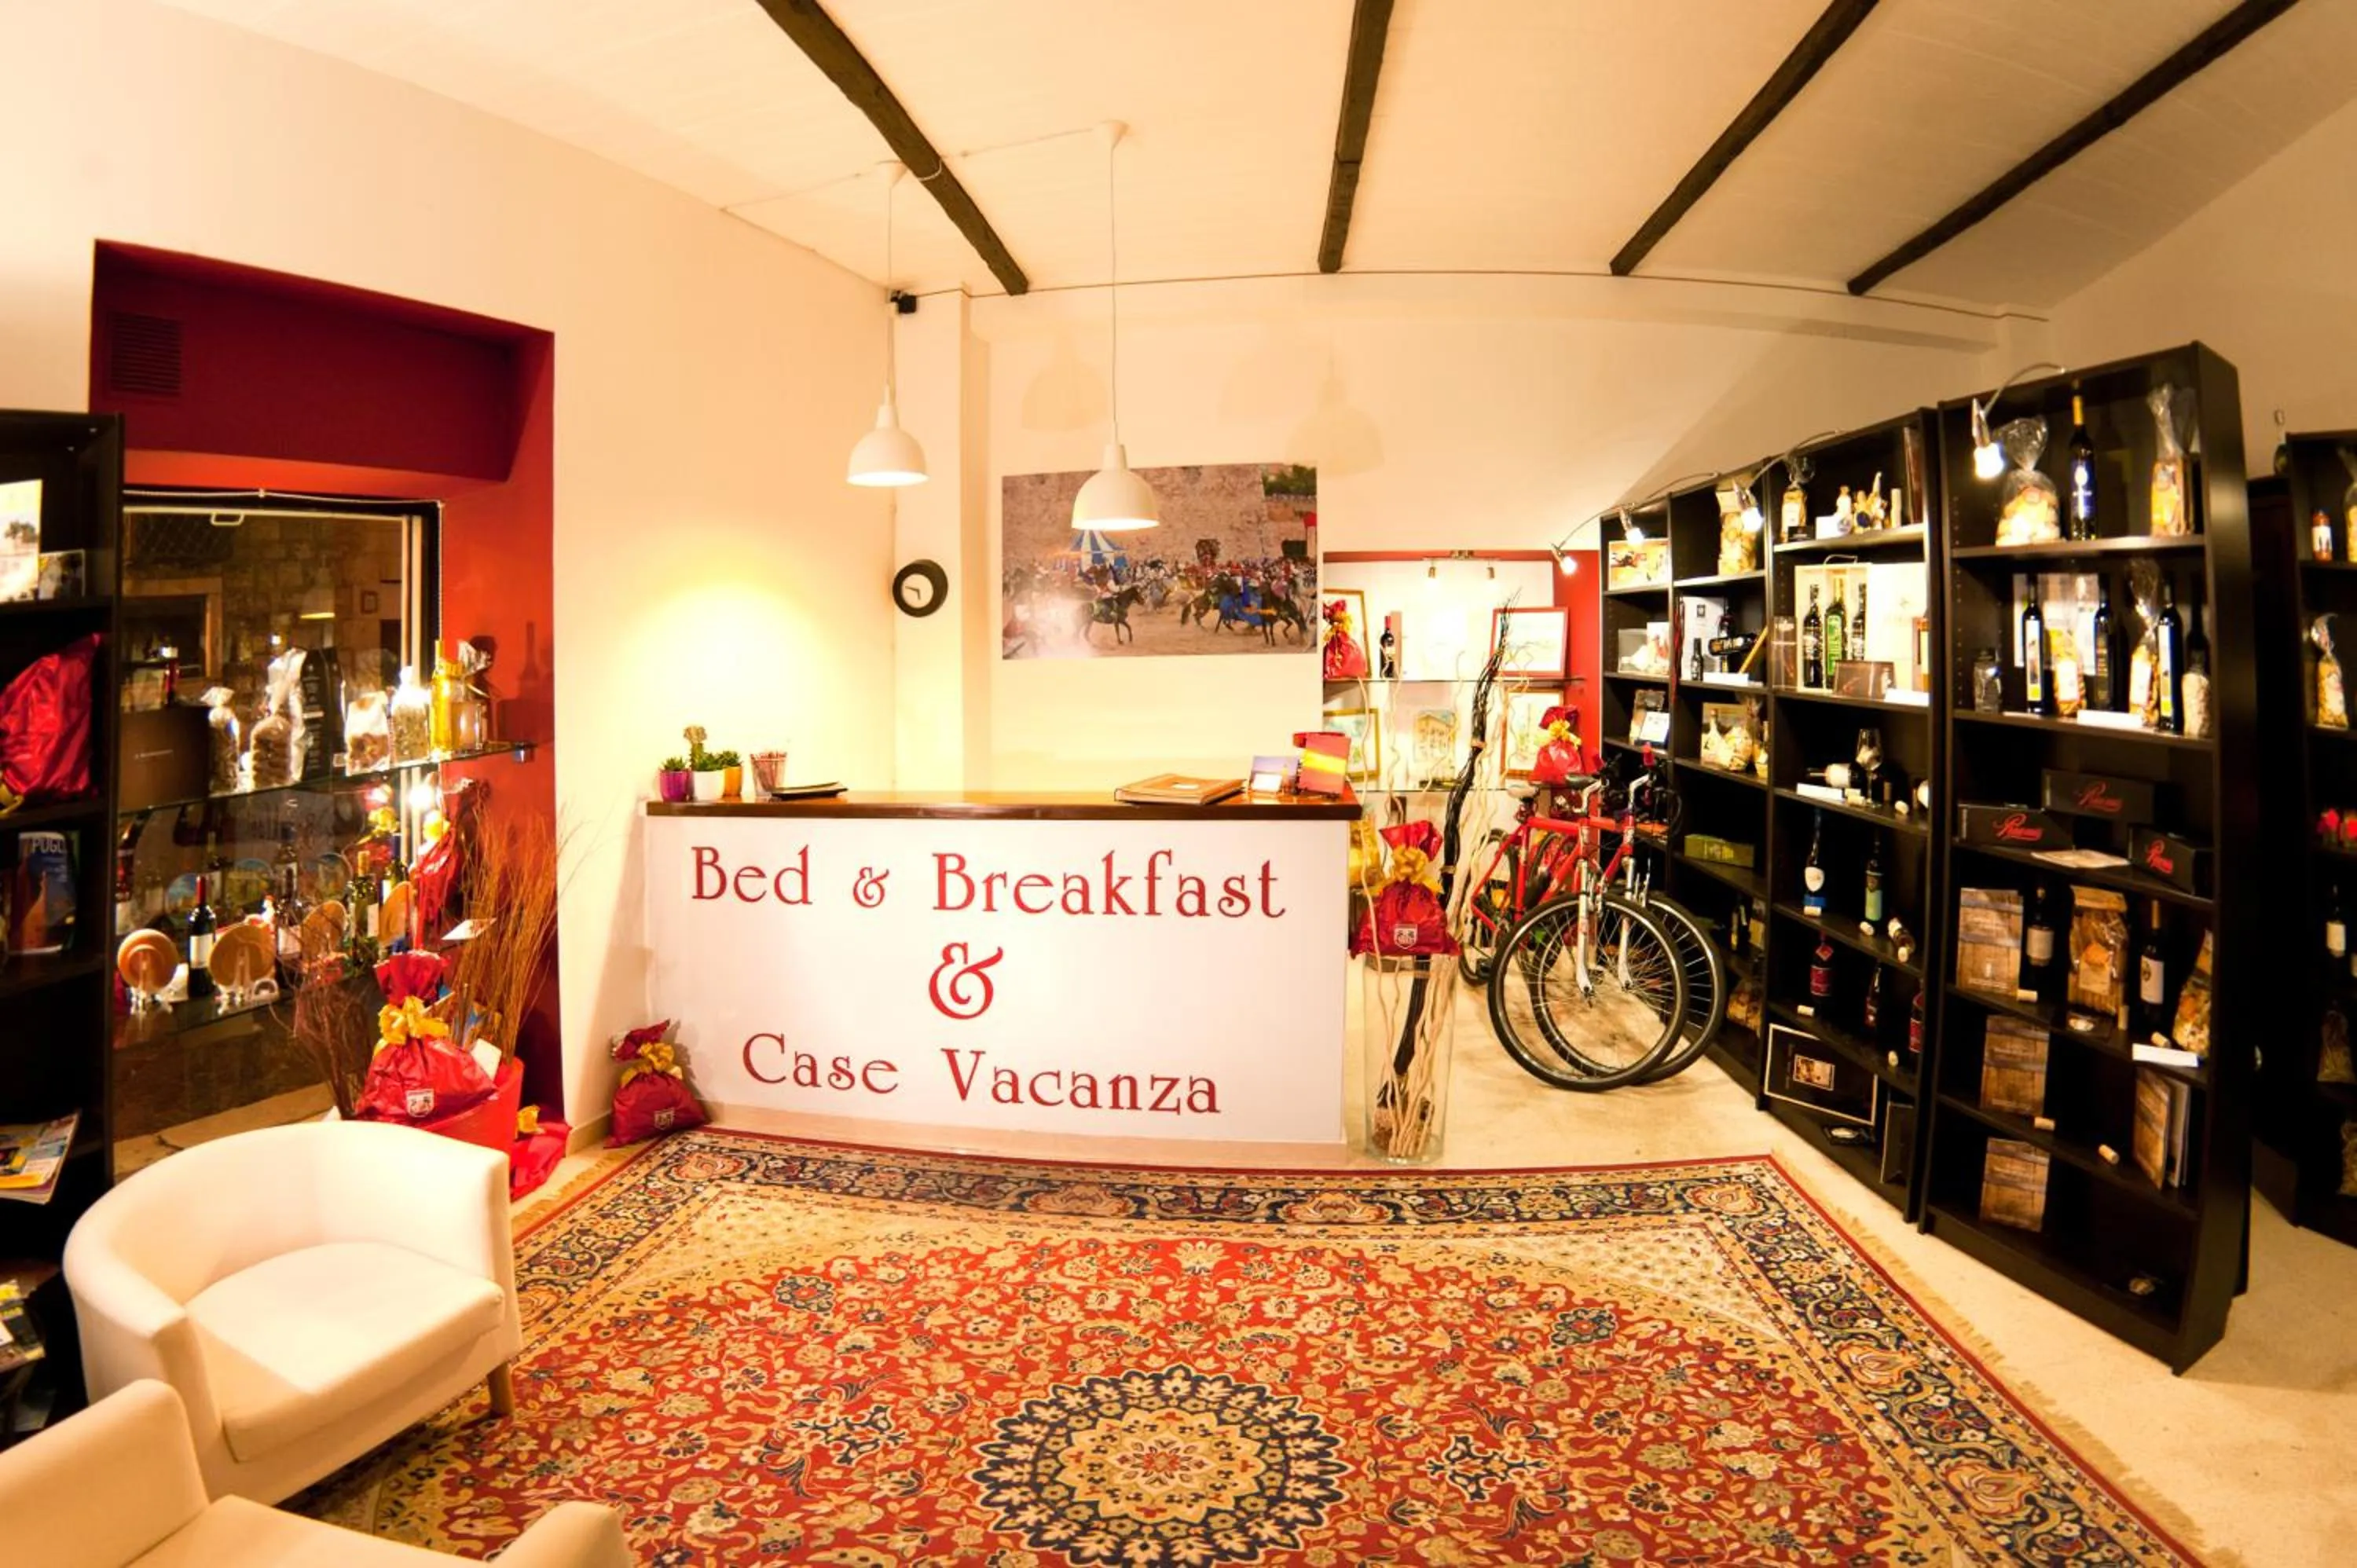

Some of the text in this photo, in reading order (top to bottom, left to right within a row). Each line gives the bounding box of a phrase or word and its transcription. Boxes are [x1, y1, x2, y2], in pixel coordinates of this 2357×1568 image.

[691, 845, 1287, 918] Bed & Breakfast
[928, 942, 1004, 1020] &
[742, 1033, 1222, 1115] Case Vacanza
